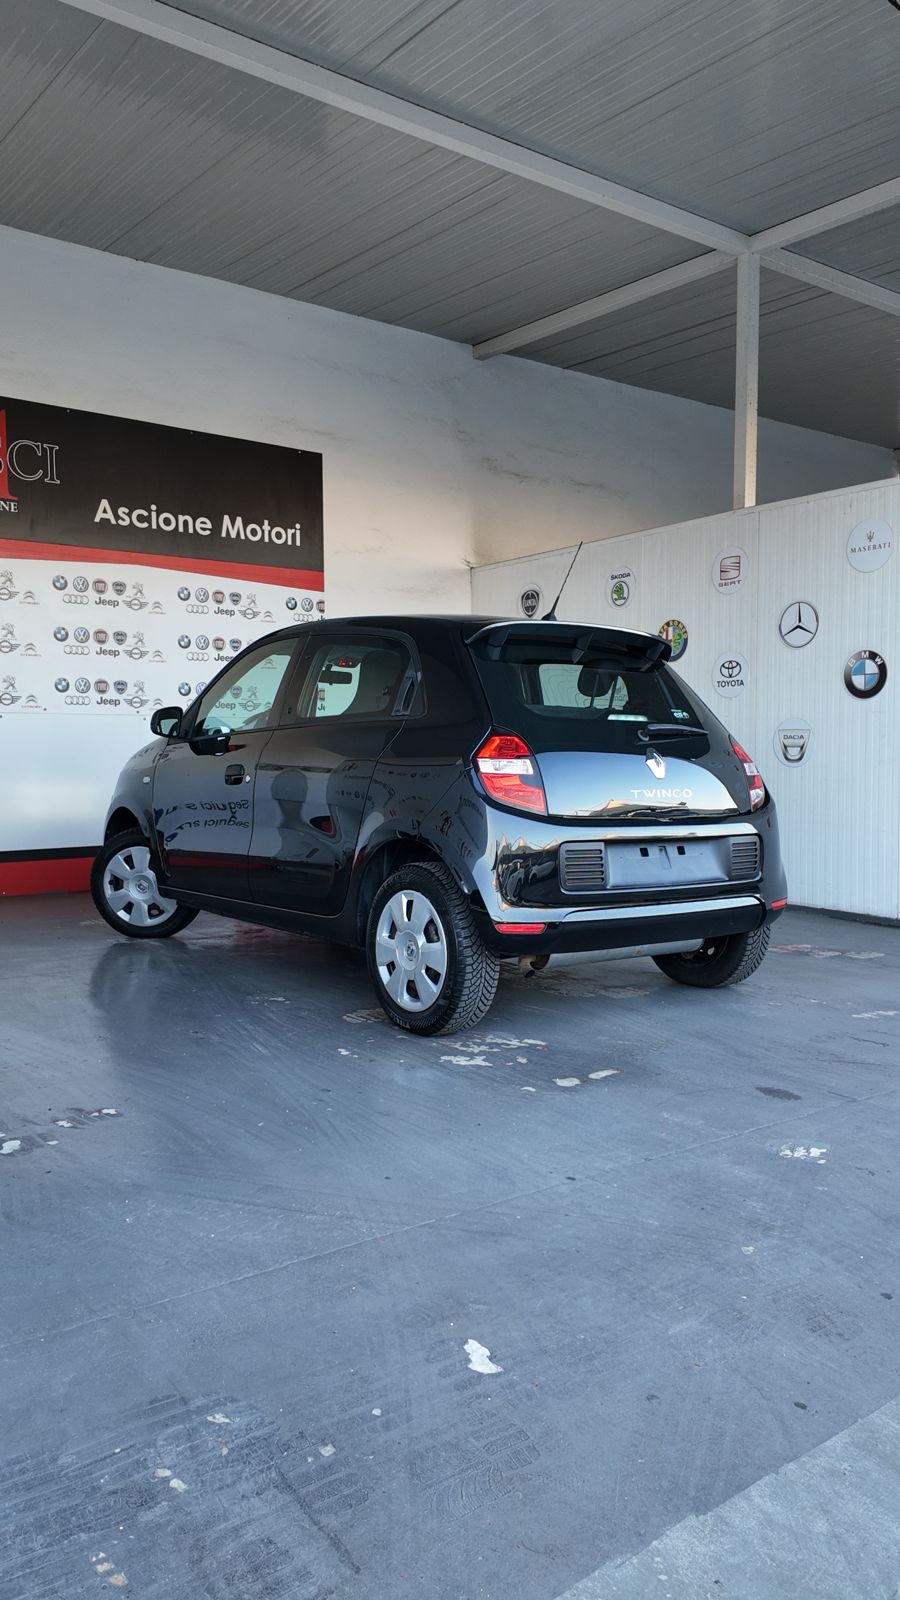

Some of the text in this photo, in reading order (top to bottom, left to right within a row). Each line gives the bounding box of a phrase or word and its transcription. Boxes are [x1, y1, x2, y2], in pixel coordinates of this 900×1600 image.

[94, 498, 301, 547] Ascione Motori
[850, 541, 891, 553] MASERATI
[718, 580, 742, 588] SEAT
[95, 597, 119, 608] Jeep
[214, 606, 235, 616] Jeep
[95, 647, 120, 658] Jeep
[848, 650, 883, 667] BMW
[716, 680, 745, 688] TOYOTA
[96, 697, 121, 707] Jeep
[215, 701, 236, 710] Jeep
[630, 788, 693, 799] TWINGO
